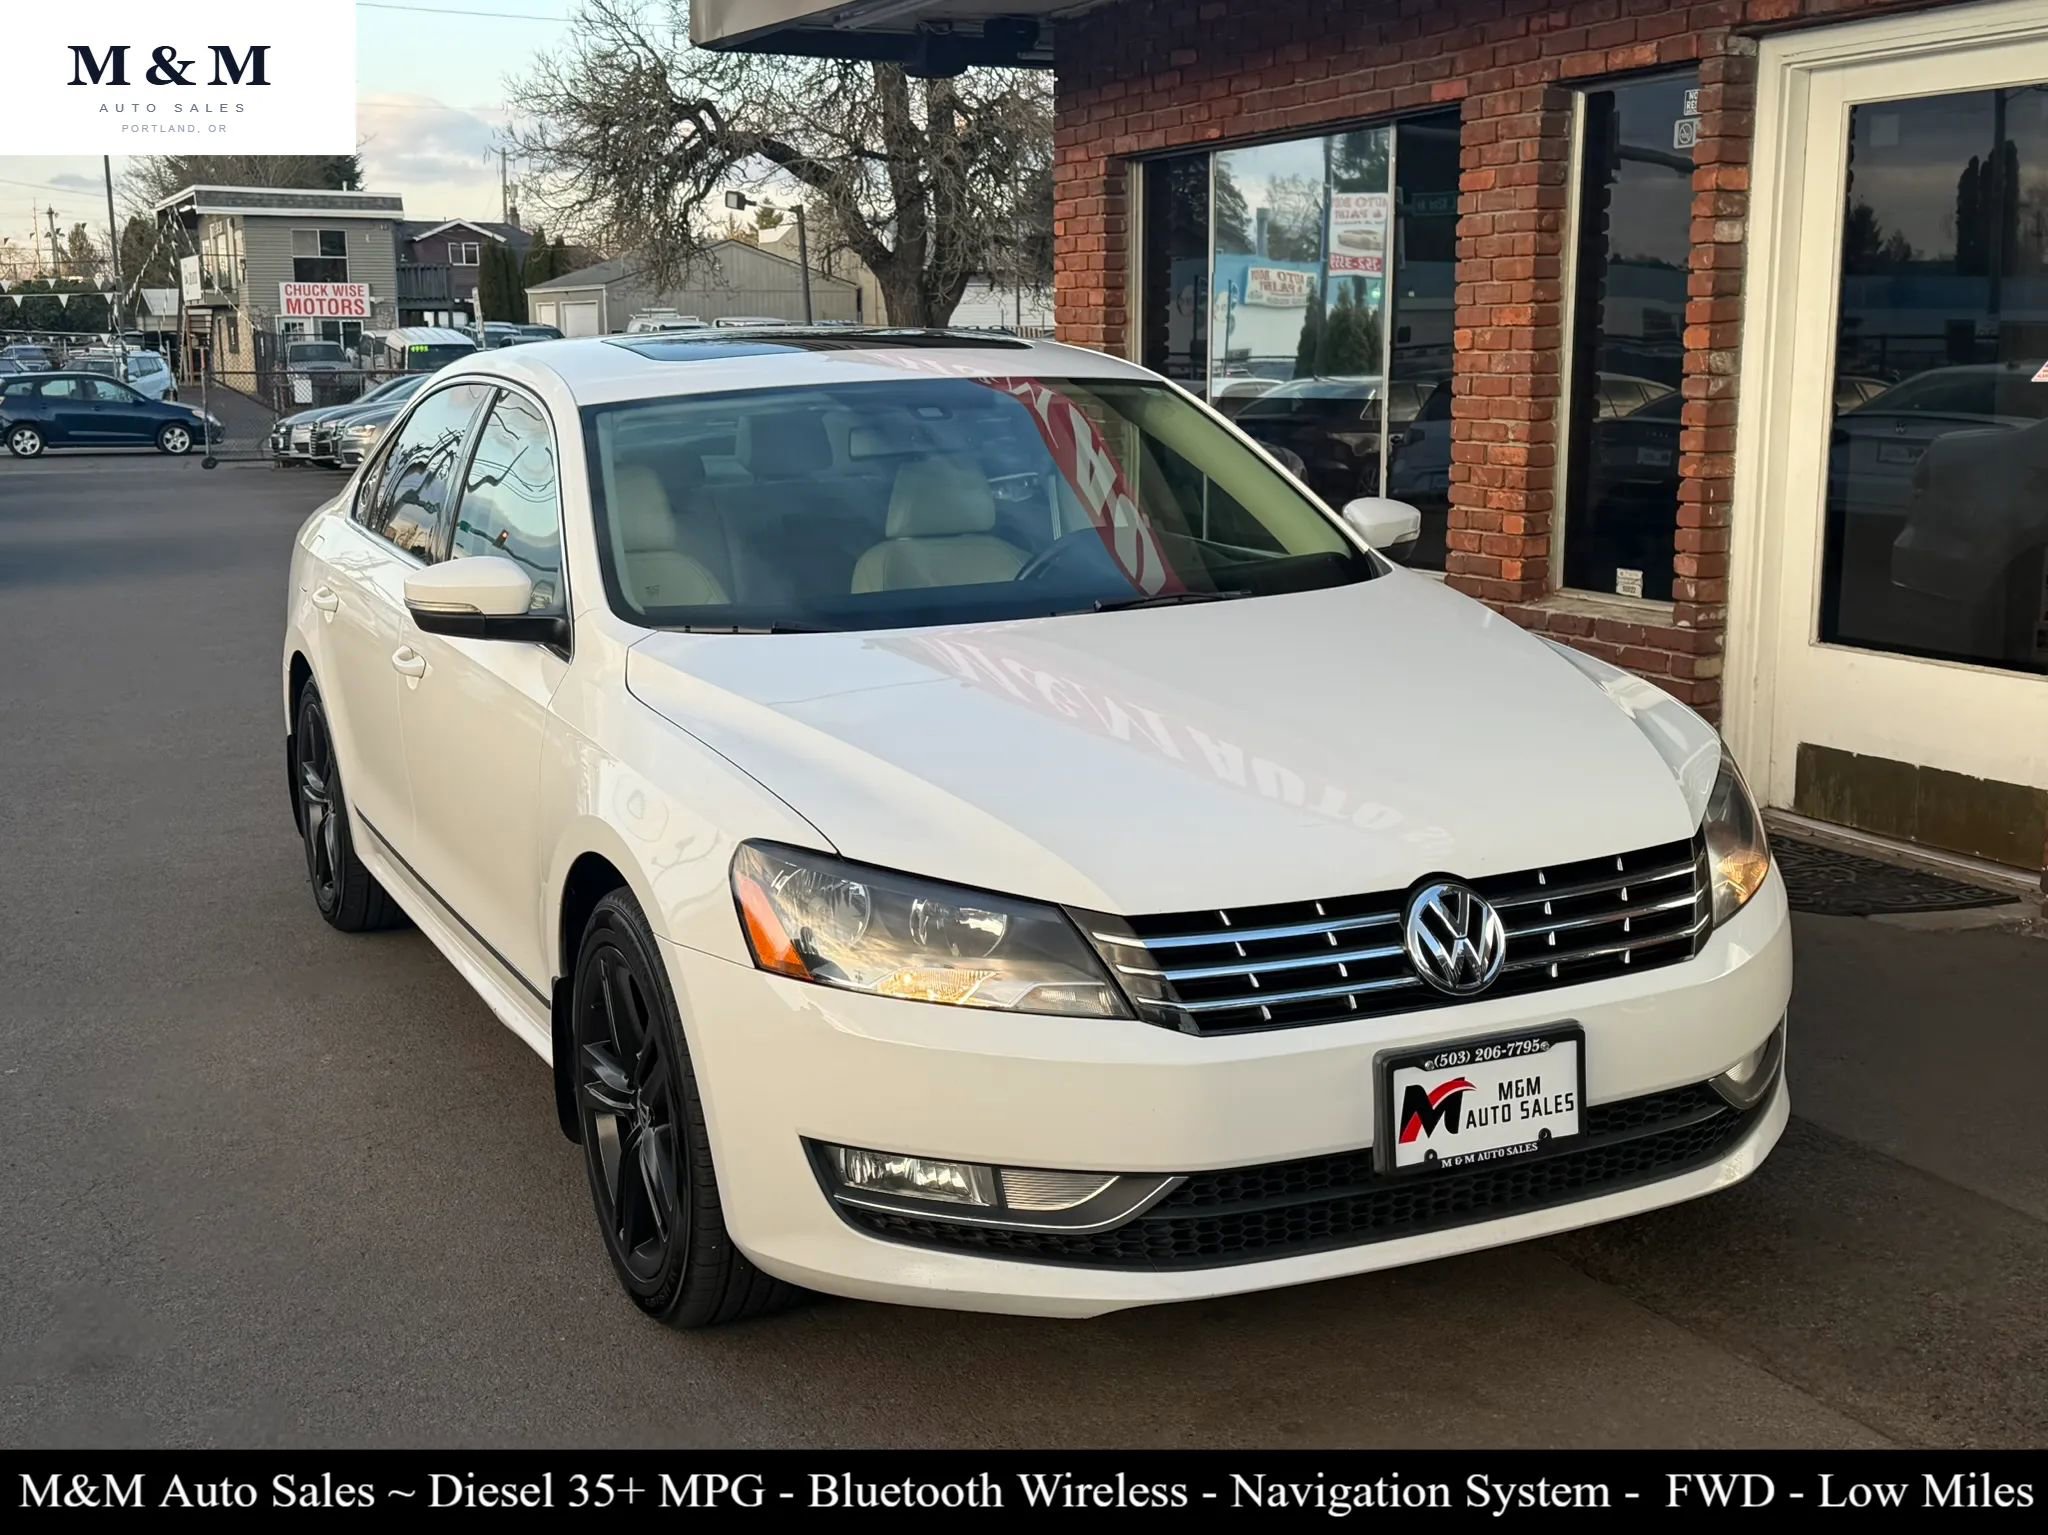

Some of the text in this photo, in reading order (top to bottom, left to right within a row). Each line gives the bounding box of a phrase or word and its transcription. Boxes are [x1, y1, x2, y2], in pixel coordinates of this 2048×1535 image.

[284, 283, 366, 297] CHUCK WISE
[286, 298, 365, 315] MOTORS
[1433, 1038, 1541, 1068] (503) 206-7795
[1466, 1093, 1574, 1129] AUTO SALES
[1441, 1142, 1538, 1168] M & M AUTO SALES
